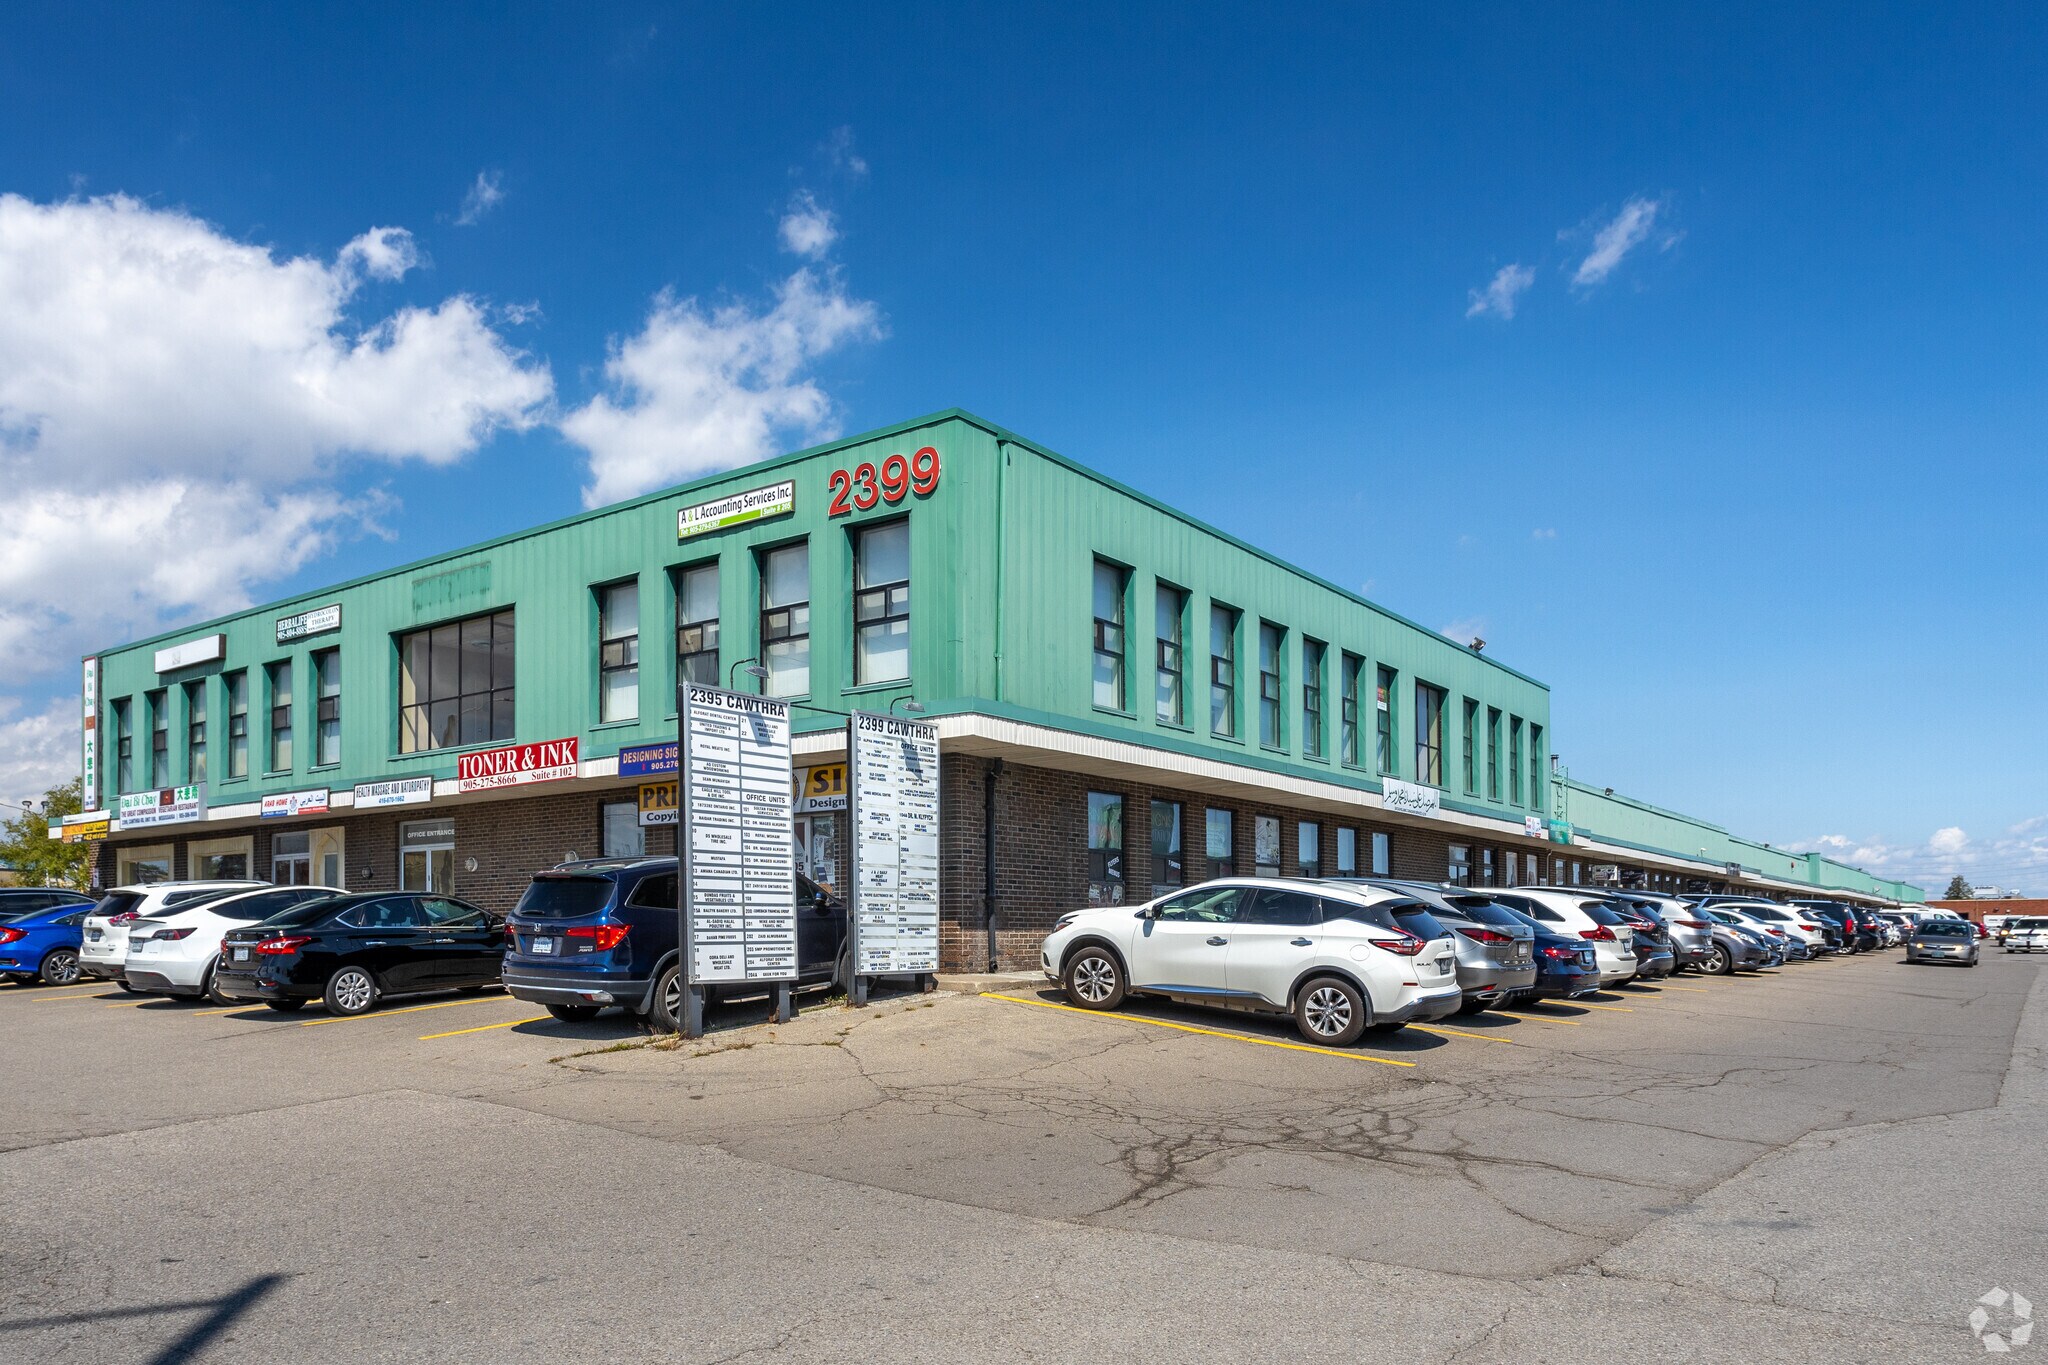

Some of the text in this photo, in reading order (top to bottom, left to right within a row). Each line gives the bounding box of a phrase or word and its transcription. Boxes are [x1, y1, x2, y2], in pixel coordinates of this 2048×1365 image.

[828, 446, 942, 517] 2399
[681, 486, 792, 524] A & L Accounting Services Inc.
[763, 506, 776, 515] Suite
[312, 615, 334, 626] THERAPY
[691, 688, 785, 718] 2395 CAWTHRA
[859, 716, 935, 741] 2399 CAWTHRA
[901, 742, 918, 751] OFFICE
[460, 740, 576, 779] TONER & INK
[623, 749, 663, 764] DESIGNING
[463, 773, 517, 790] 905-275-8666
[531, 767, 573, 781] Suite # 102
[813, 768, 847, 793] SI
[356, 780, 429, 798] HEALTH MASSAGE AND NATUROPATHY
[276, 798, 288, 806] HOME
[746, 794, 786, 804] OFFICE UNITS
[647, 810, 678, 822] Copyi
[407, 829, 455, 839] OFFICE ENTRANCE
